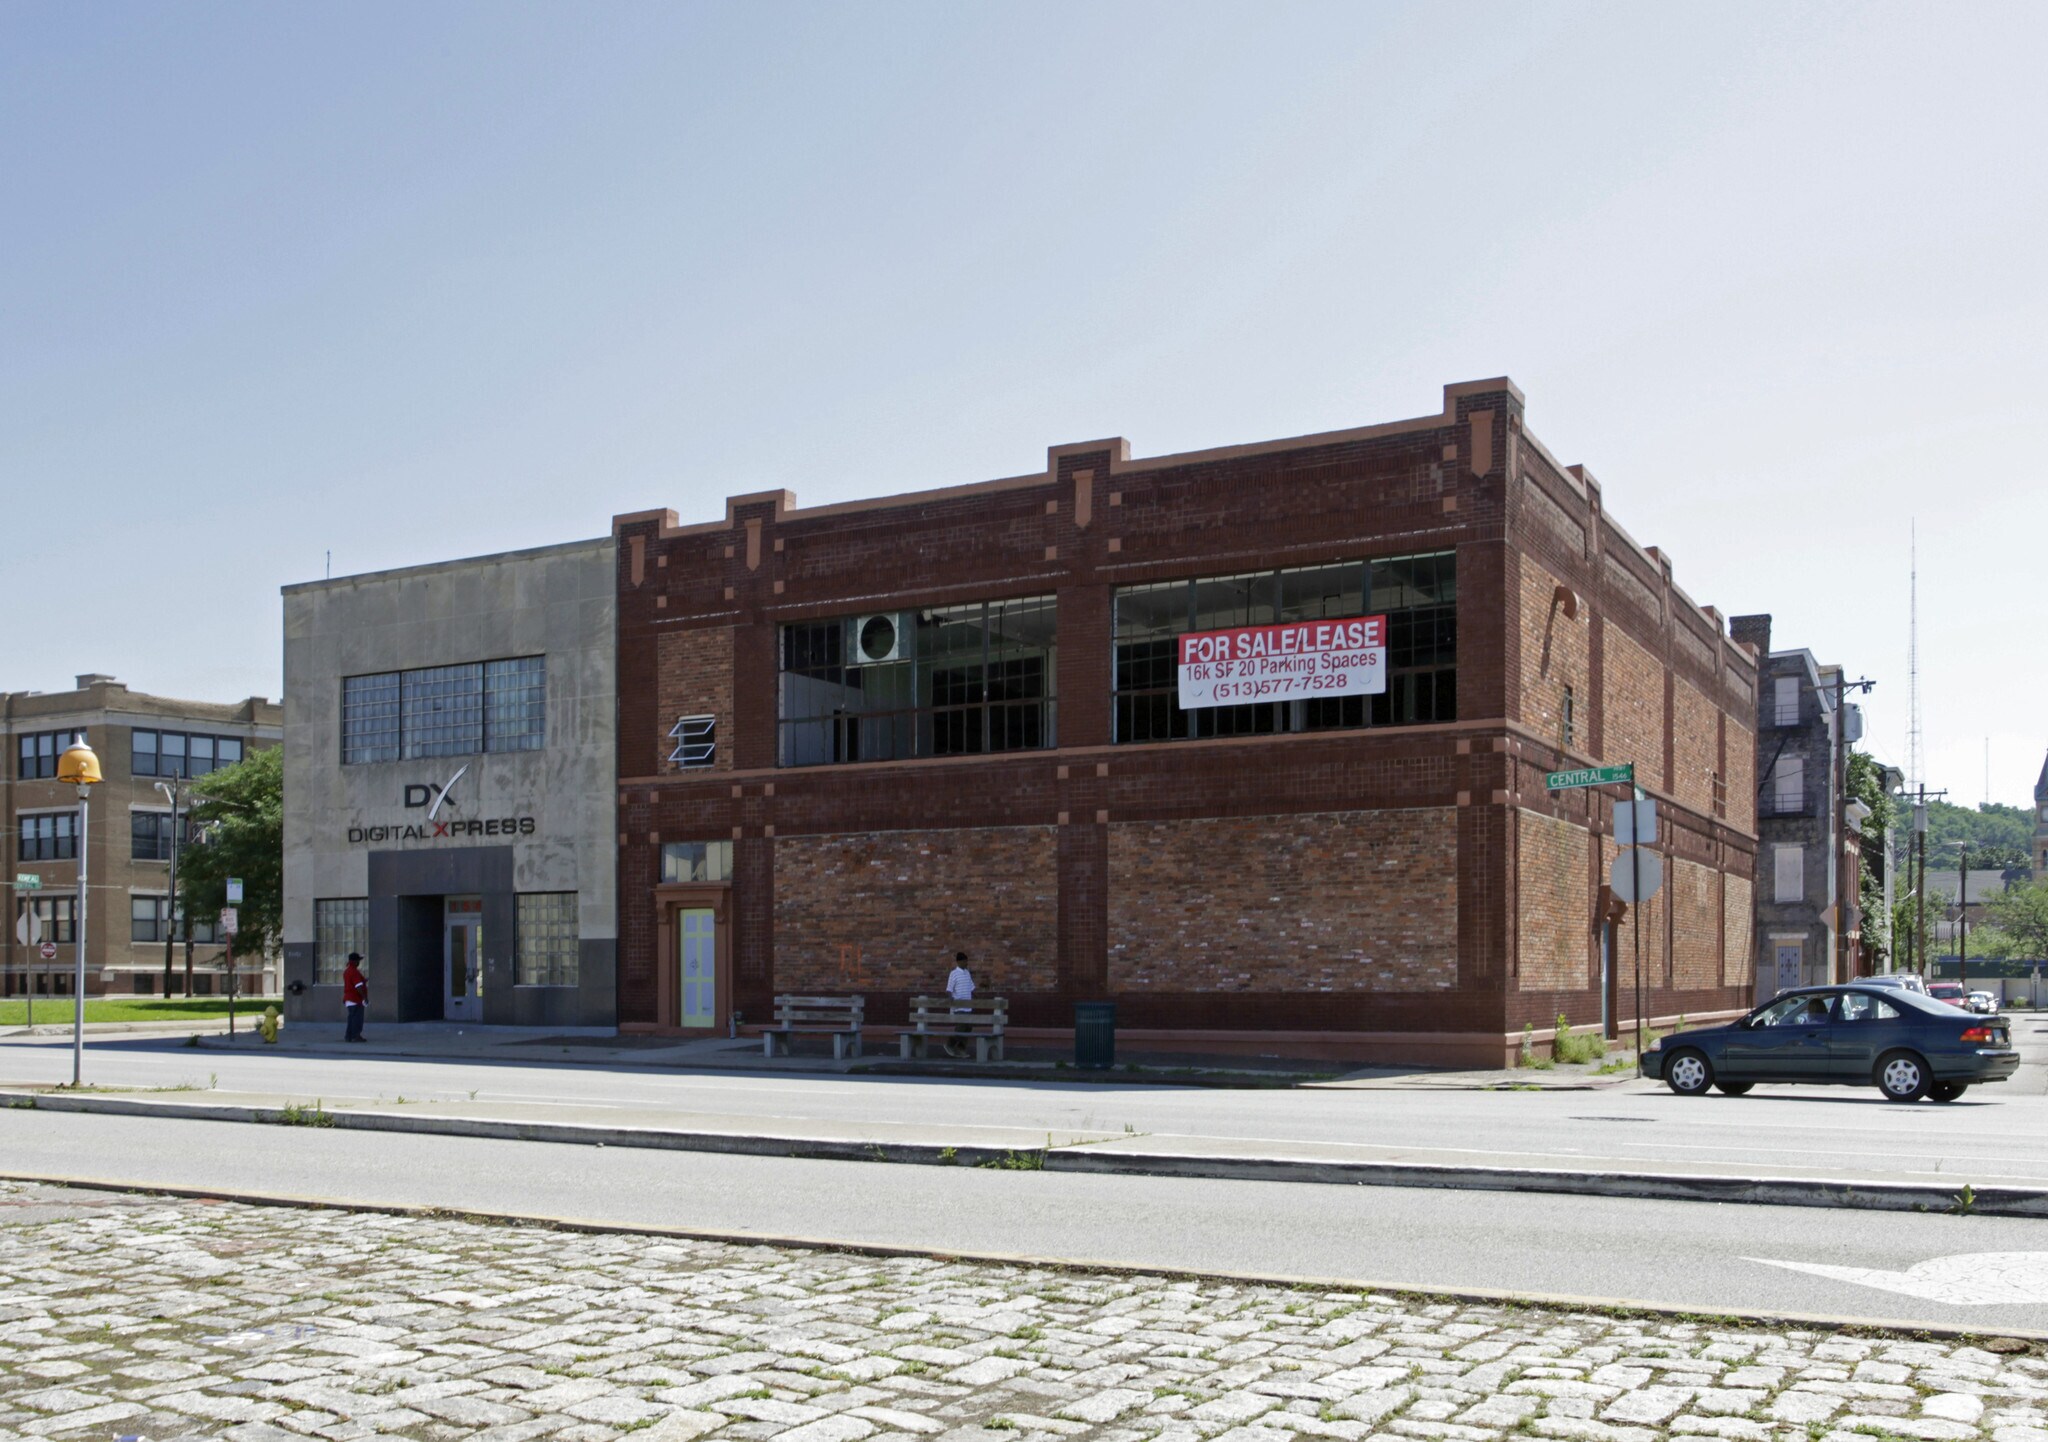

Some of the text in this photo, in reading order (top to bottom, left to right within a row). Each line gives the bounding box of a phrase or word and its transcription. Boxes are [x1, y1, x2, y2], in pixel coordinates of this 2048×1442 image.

[1184, 621, 1379, 663] FOR SALE/LEASE
[1186, 651, 1377, 681] 16k SF 20 Parking Spaces
[1550, 770, 1605, 786] CENTRAL
